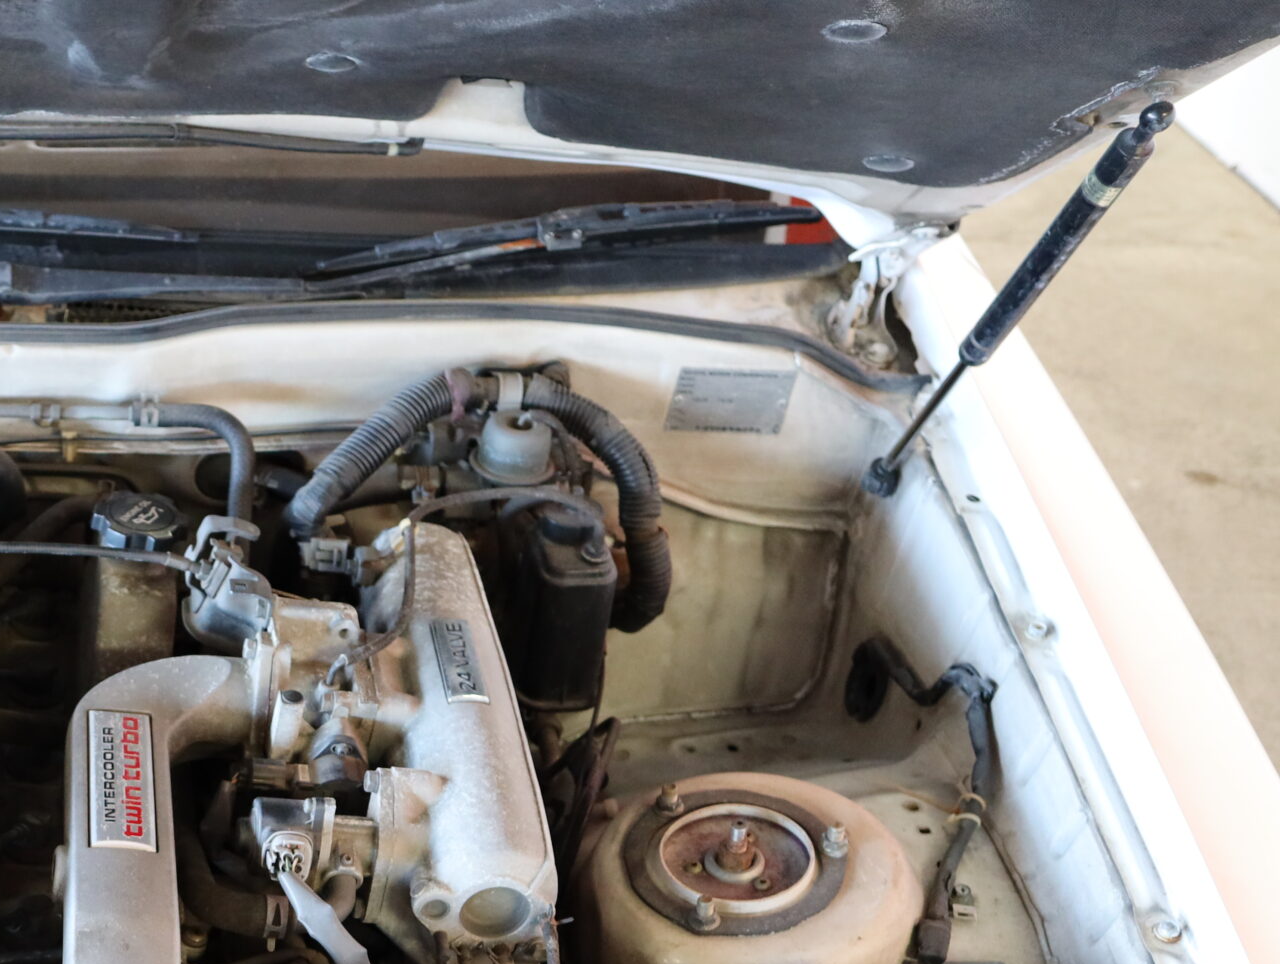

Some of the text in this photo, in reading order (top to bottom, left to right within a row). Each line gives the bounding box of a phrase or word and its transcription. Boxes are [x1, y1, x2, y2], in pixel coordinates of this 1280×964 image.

[446, 623, 477, 692] 24 VALVE
[102, 727, 116, 822] INTERCOOLER
[120, 716, 144, 838] twin turbo
